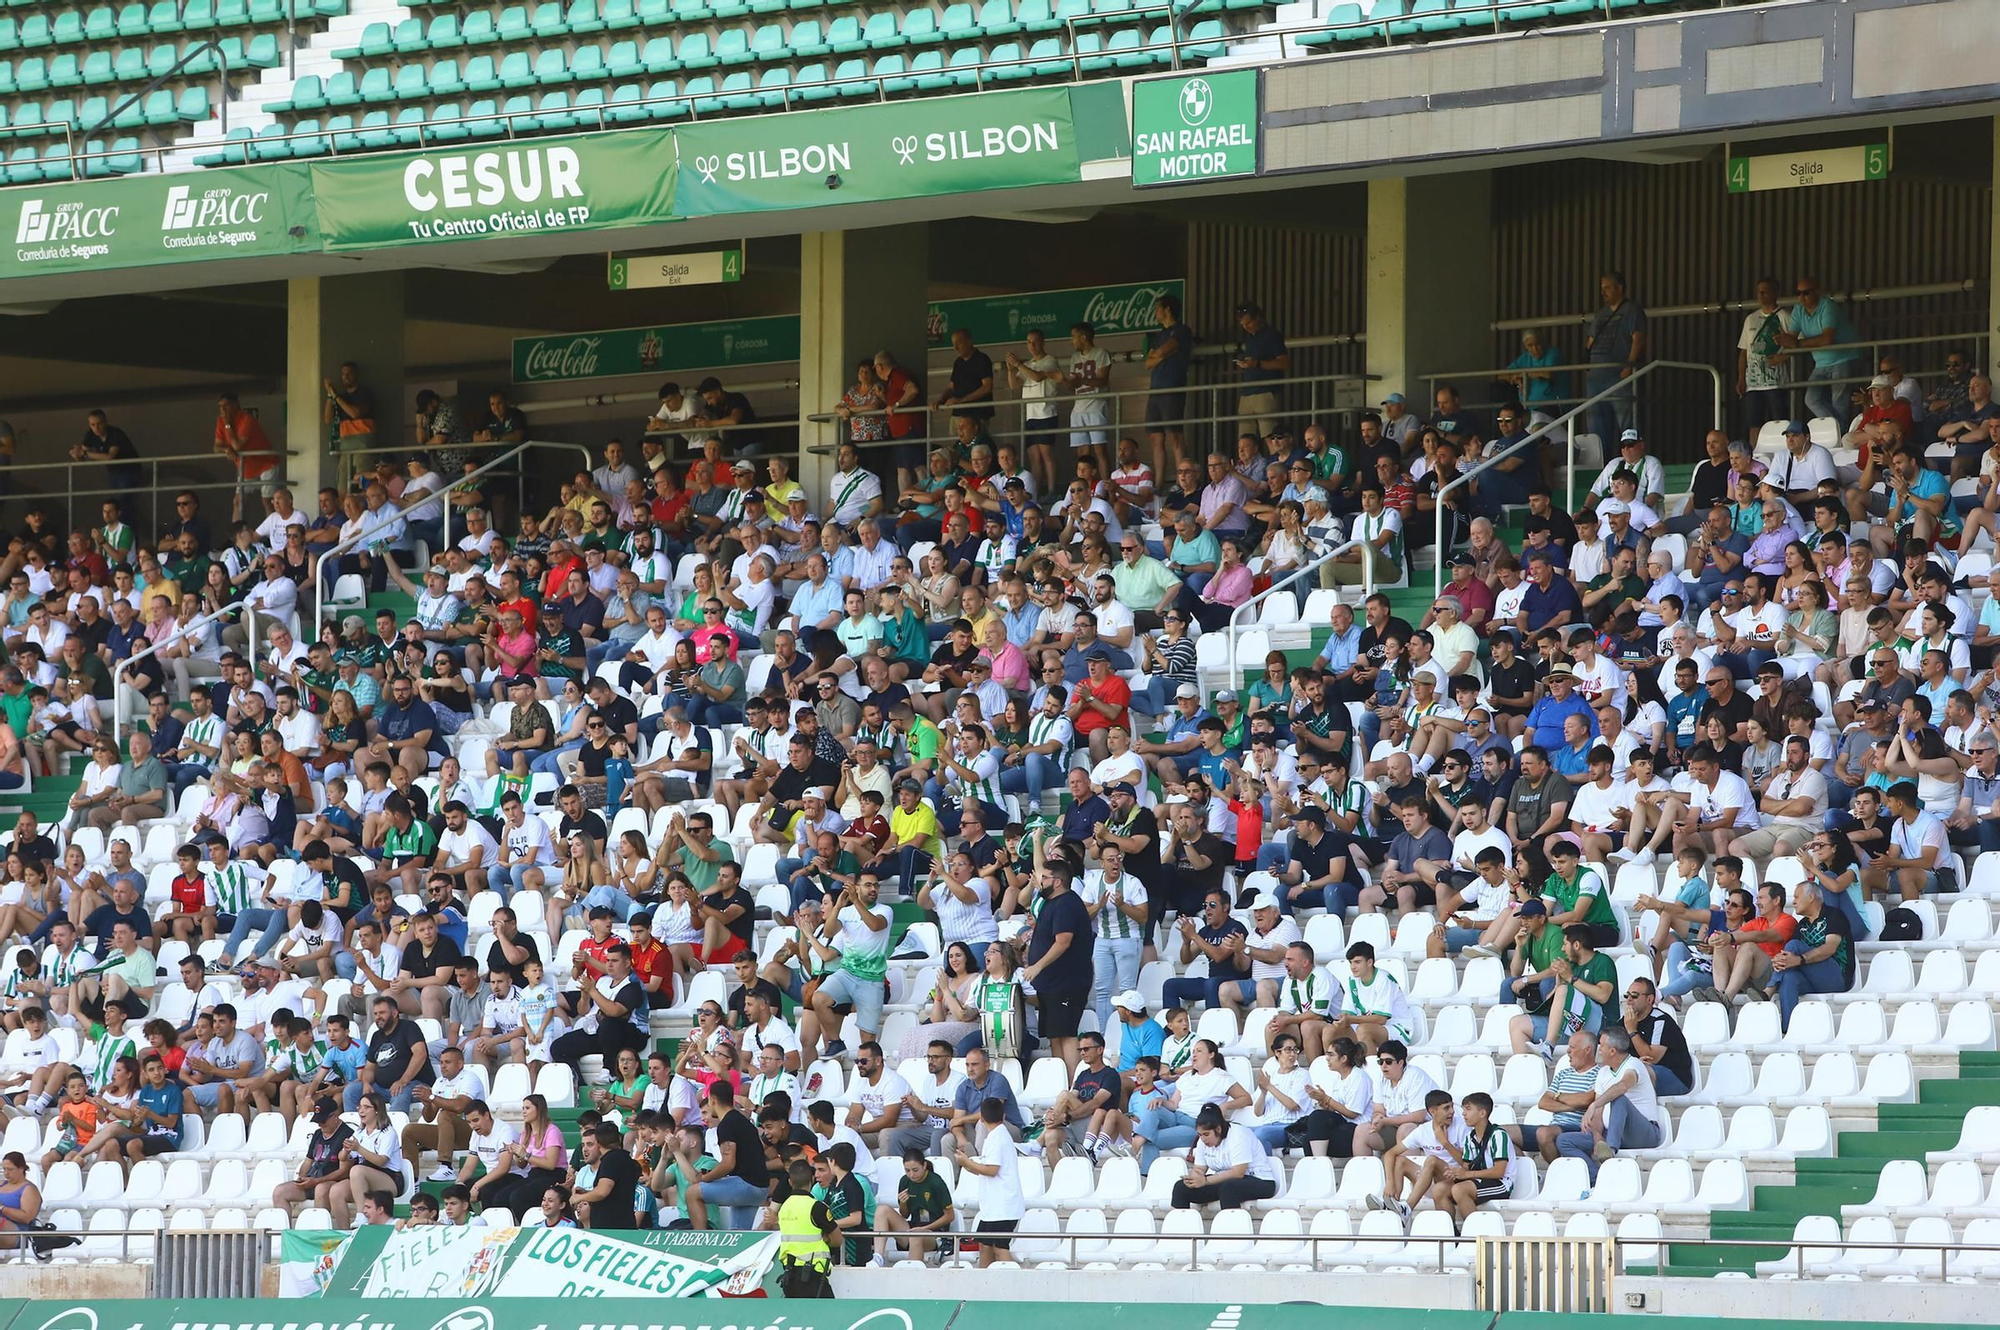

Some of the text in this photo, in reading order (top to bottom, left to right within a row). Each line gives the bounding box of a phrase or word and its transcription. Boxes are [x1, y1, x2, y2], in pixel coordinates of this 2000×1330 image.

[926, 121, 1059, 163] SILBON
[1137, 123, 1253, 155] SAN RAFAEL
[727, 142, 851, 181] SILBON
[1159, 152, 1228, 178] MOTOR
[1790, 162, 1823, 177] Salida
[1869, 149, 1882, 174] 5
[404, 146, 584, 210] CESUR
[1731, 162, 1745, 187] 4
[1799, 175, 1813, 185] Exit
[204, 188, 231, 199] GRUPO
[57, 202, 84, 212] GRUPO
[196, 192, 268, 228] PACC
[49, 206, 120, 240] PACC
[409, 205, 590, 238] Tu Centro Oficial de FP
[207, 231, 218, 245] de
[218, 229, 257, 247] Seguros
[59, 244, 71, 258] de
[71, 243, 109, 260] Seguros
[613, 263, 625, 285] 3
[661, 264, 689, 277] Salida
[725, 254, 737, 278] 4
[669, 276, 681, 285] Exit
[525, 337, 604, 379] Coca-Cola
[643, 1232, 742, 1247] LA TABERNA DE
[528, 1229, 591, 1268] LOS
[583, 1244, 685, 1293] FIELES
